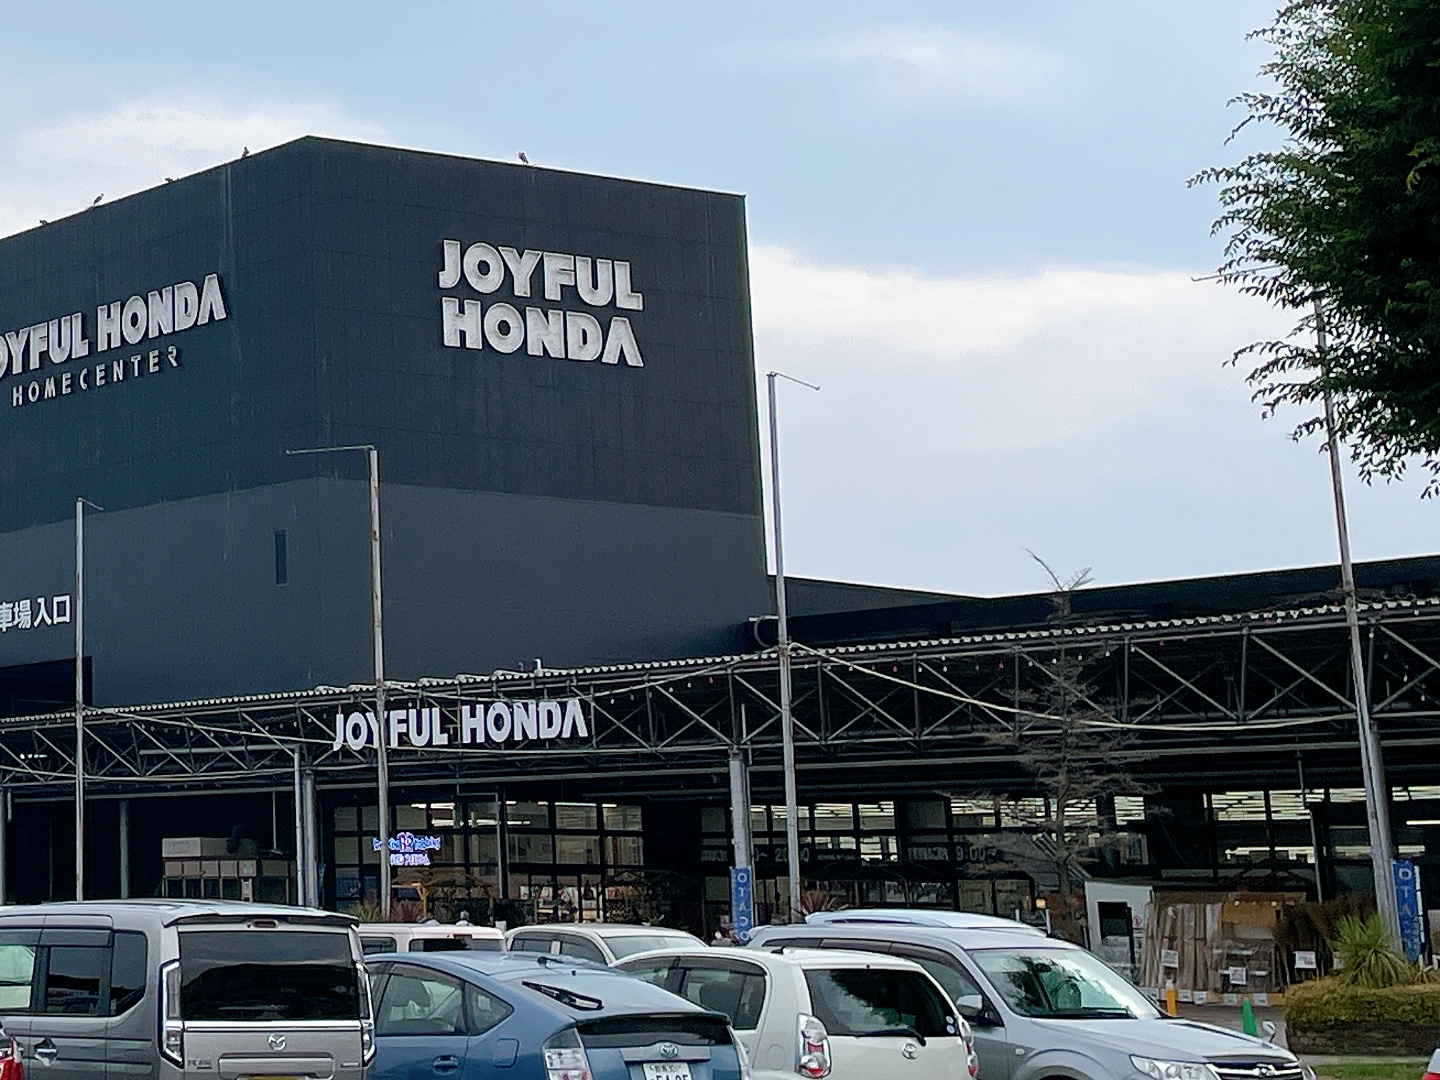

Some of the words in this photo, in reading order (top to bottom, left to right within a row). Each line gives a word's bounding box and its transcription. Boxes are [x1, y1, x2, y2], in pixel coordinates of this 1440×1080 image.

[438, 238, 644, 311] JOYFUL
[97, 273, 228, 353] HONDA
[441, 296, 644, 368] HONDA
[332, 706, 449, 752] JOYFUL
[460, 697, 589, 744] HONDA
